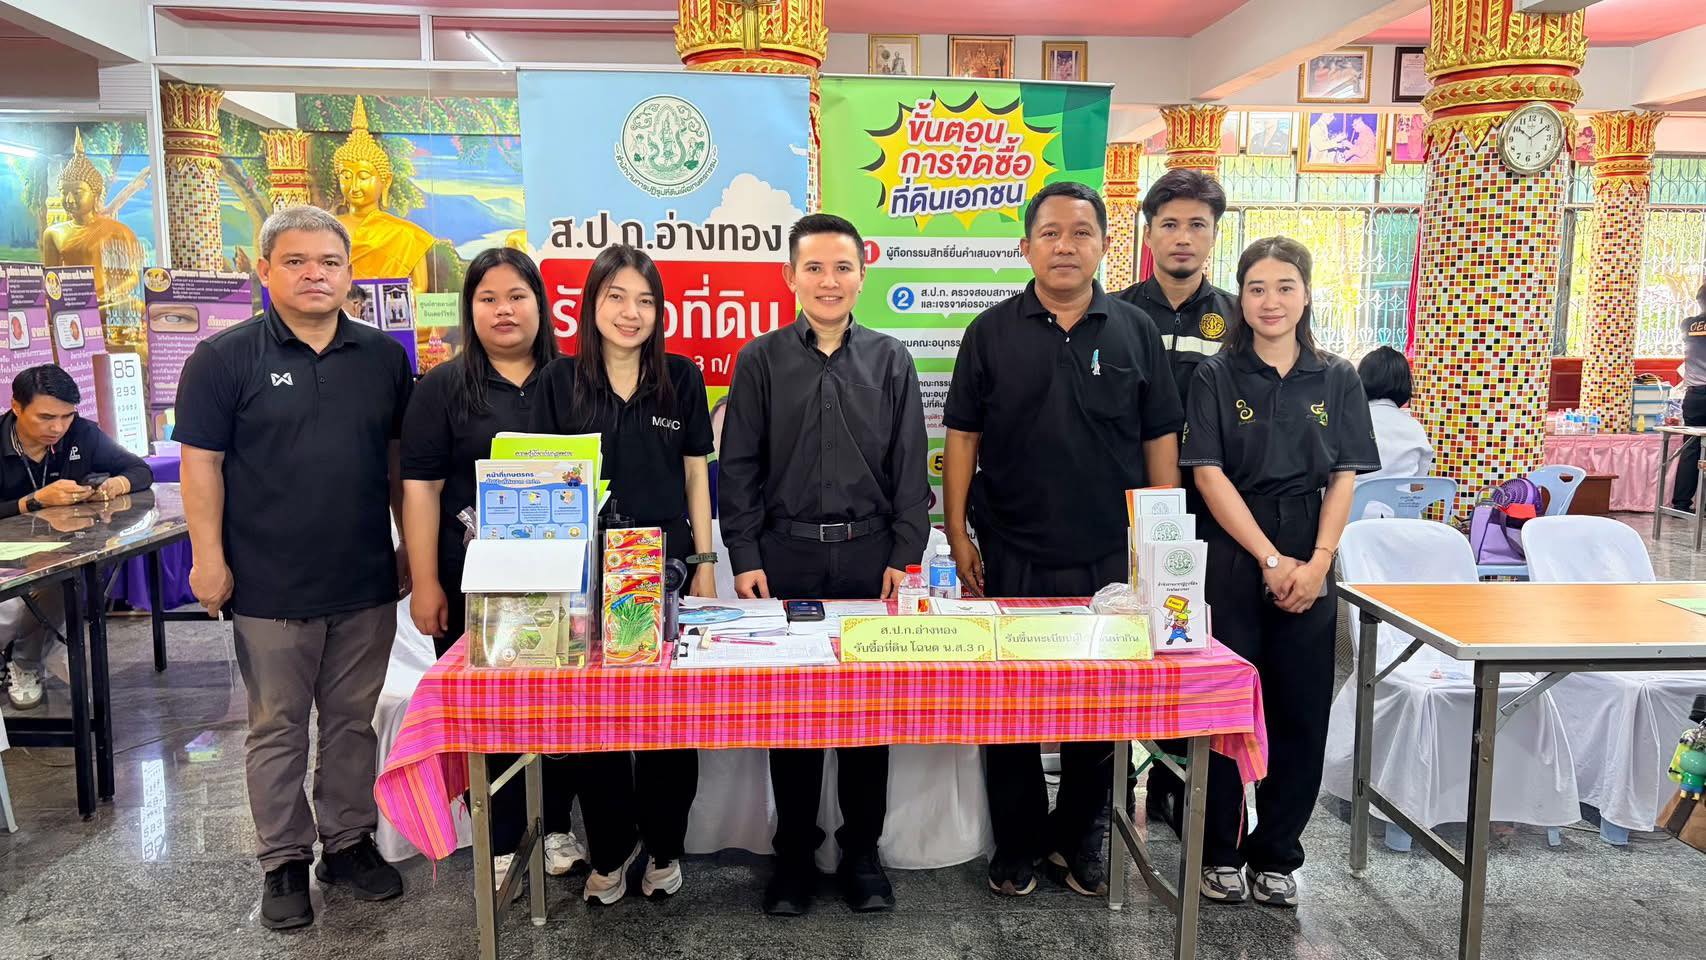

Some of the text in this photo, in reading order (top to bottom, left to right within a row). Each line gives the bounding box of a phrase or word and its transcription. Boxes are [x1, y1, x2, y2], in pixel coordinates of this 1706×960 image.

[909, 102, 1005, 143] ขั้นตอน
[901, 137, 1032, 176] การจัดซื้อ
[891, 177, 1024, 214] ที่ดินเอกชน
[864, 244, 872, 260] 1
[897, 289, 910, 307] 2
[921, 286, 949, 297] ส.ป.ก.
[113, 360, 135, 378] 85
[116, 385, 136, 397] 293
[934, 456, 943, 470] 5
[880, 624, 957, 635] ส.ป.ก.อ่างทอง
[853, 640, 907, 653] รับซื้อที่ดิน
[910, 641, 939, 653] โฉนด
